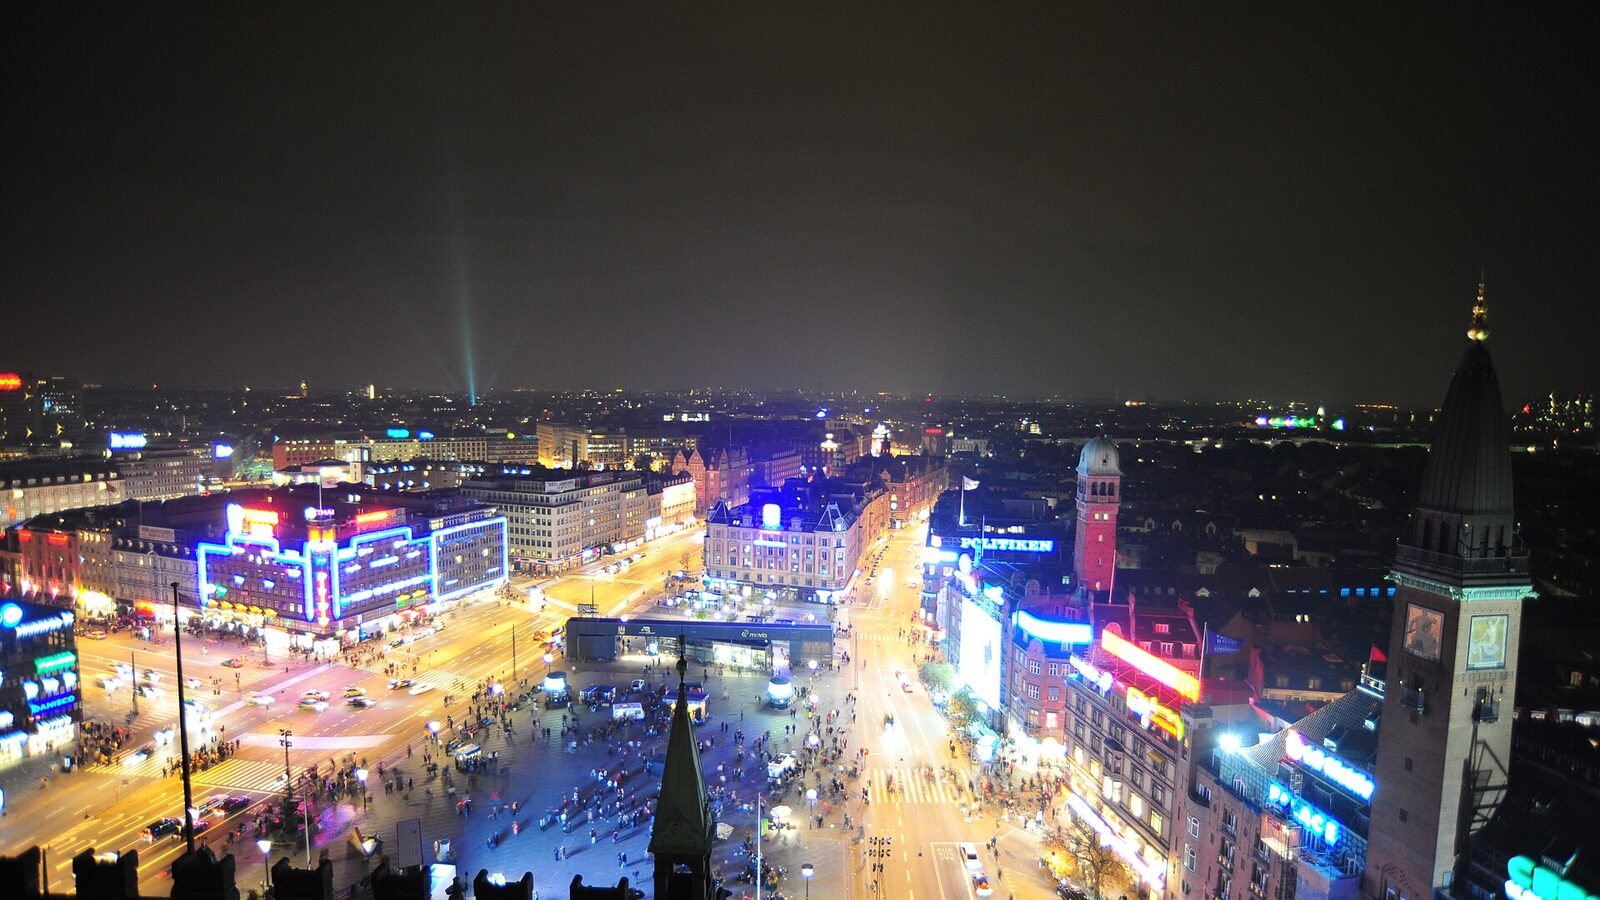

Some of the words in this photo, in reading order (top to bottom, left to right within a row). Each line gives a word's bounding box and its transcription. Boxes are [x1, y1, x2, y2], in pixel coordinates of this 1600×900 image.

[317, 508, 335, 516] THAI
[960, 537, 1053, 552] POLITIKEN
[749, 631, 768, 639] movia
[31, 695, 76, 714] DANISCO
[937, 847, 954, 860] BUS
